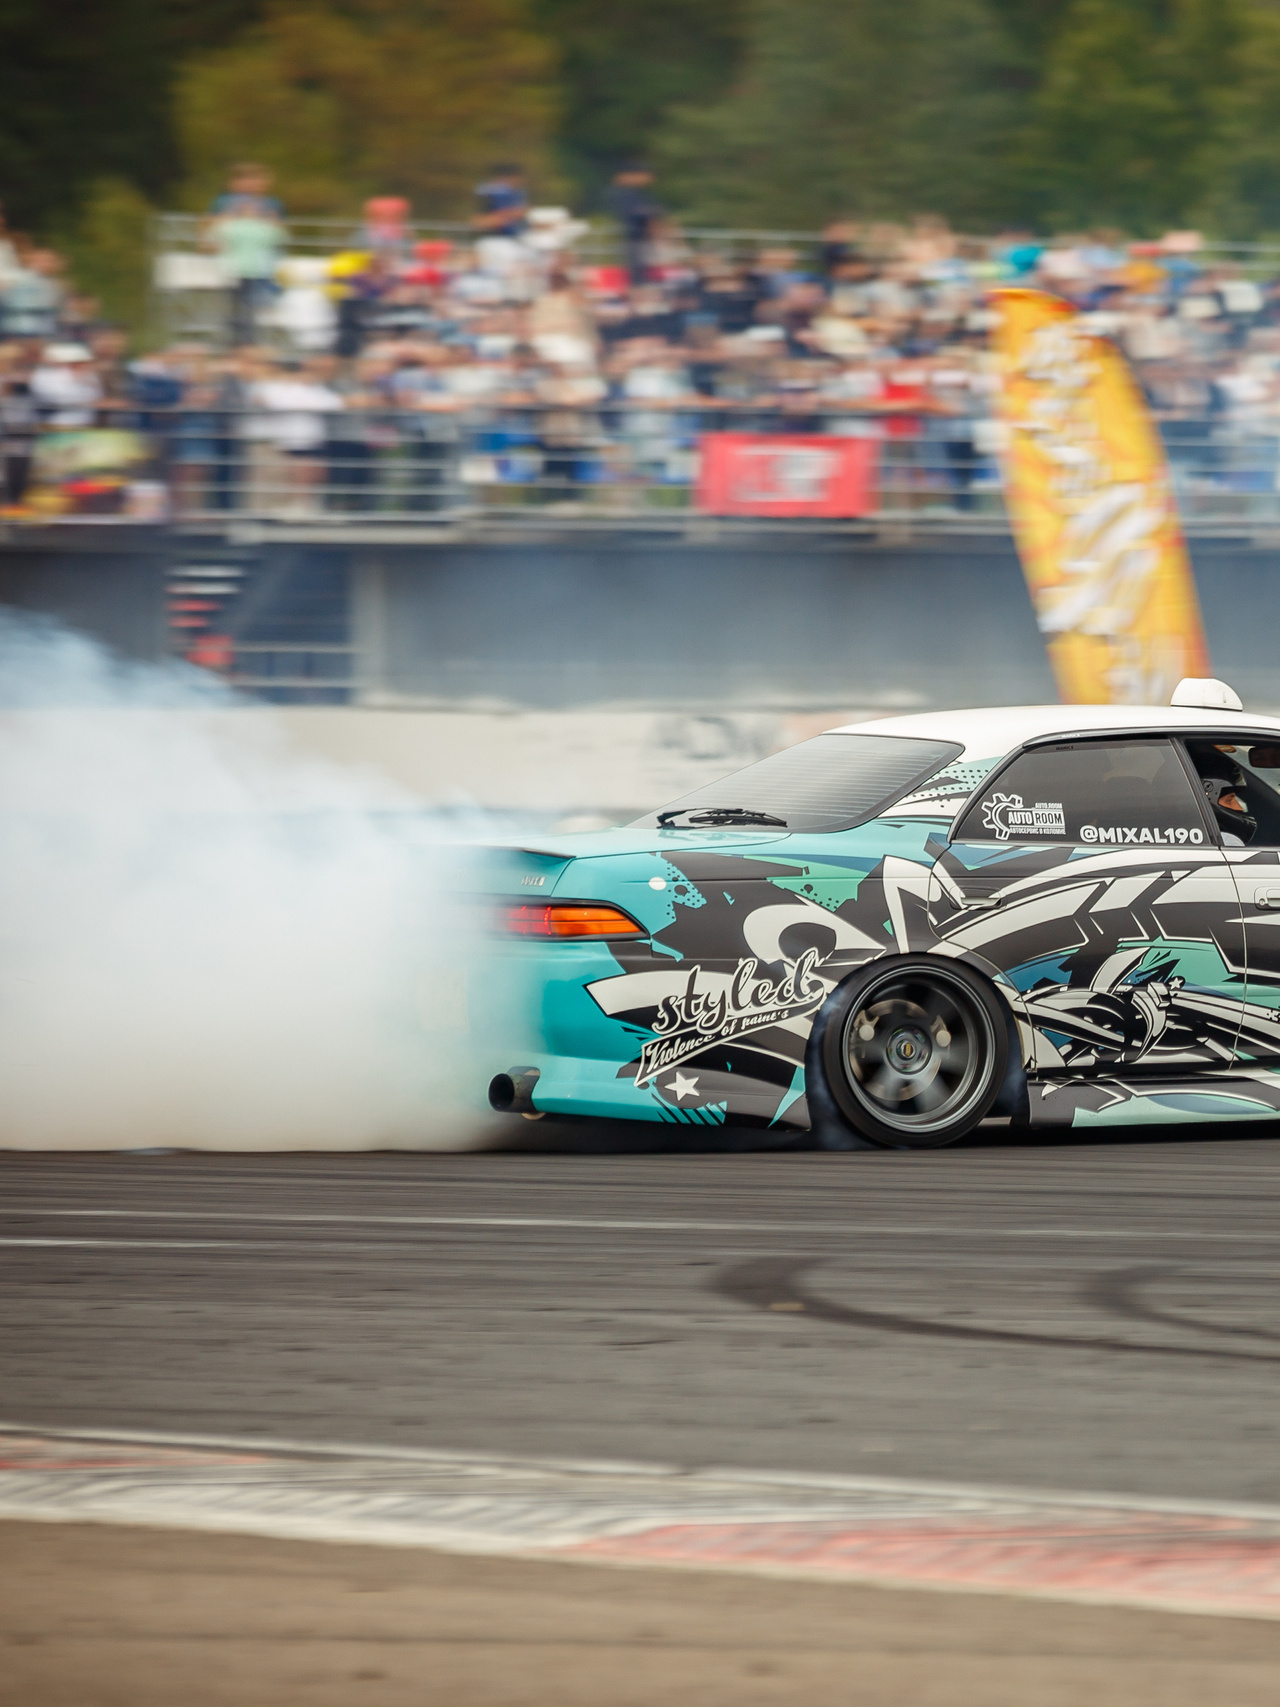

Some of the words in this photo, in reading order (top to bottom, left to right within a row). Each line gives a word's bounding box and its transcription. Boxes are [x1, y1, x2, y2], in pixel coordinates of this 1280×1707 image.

[1008, 811, 1033, 825] AUTO
[1035, 812, 1063, 825] ROOM
[1080, 825, 1203, 844] @MIXAL190
[645, 1034, 716, 1074] Violence
[721, 1018, 738, 1037] of
